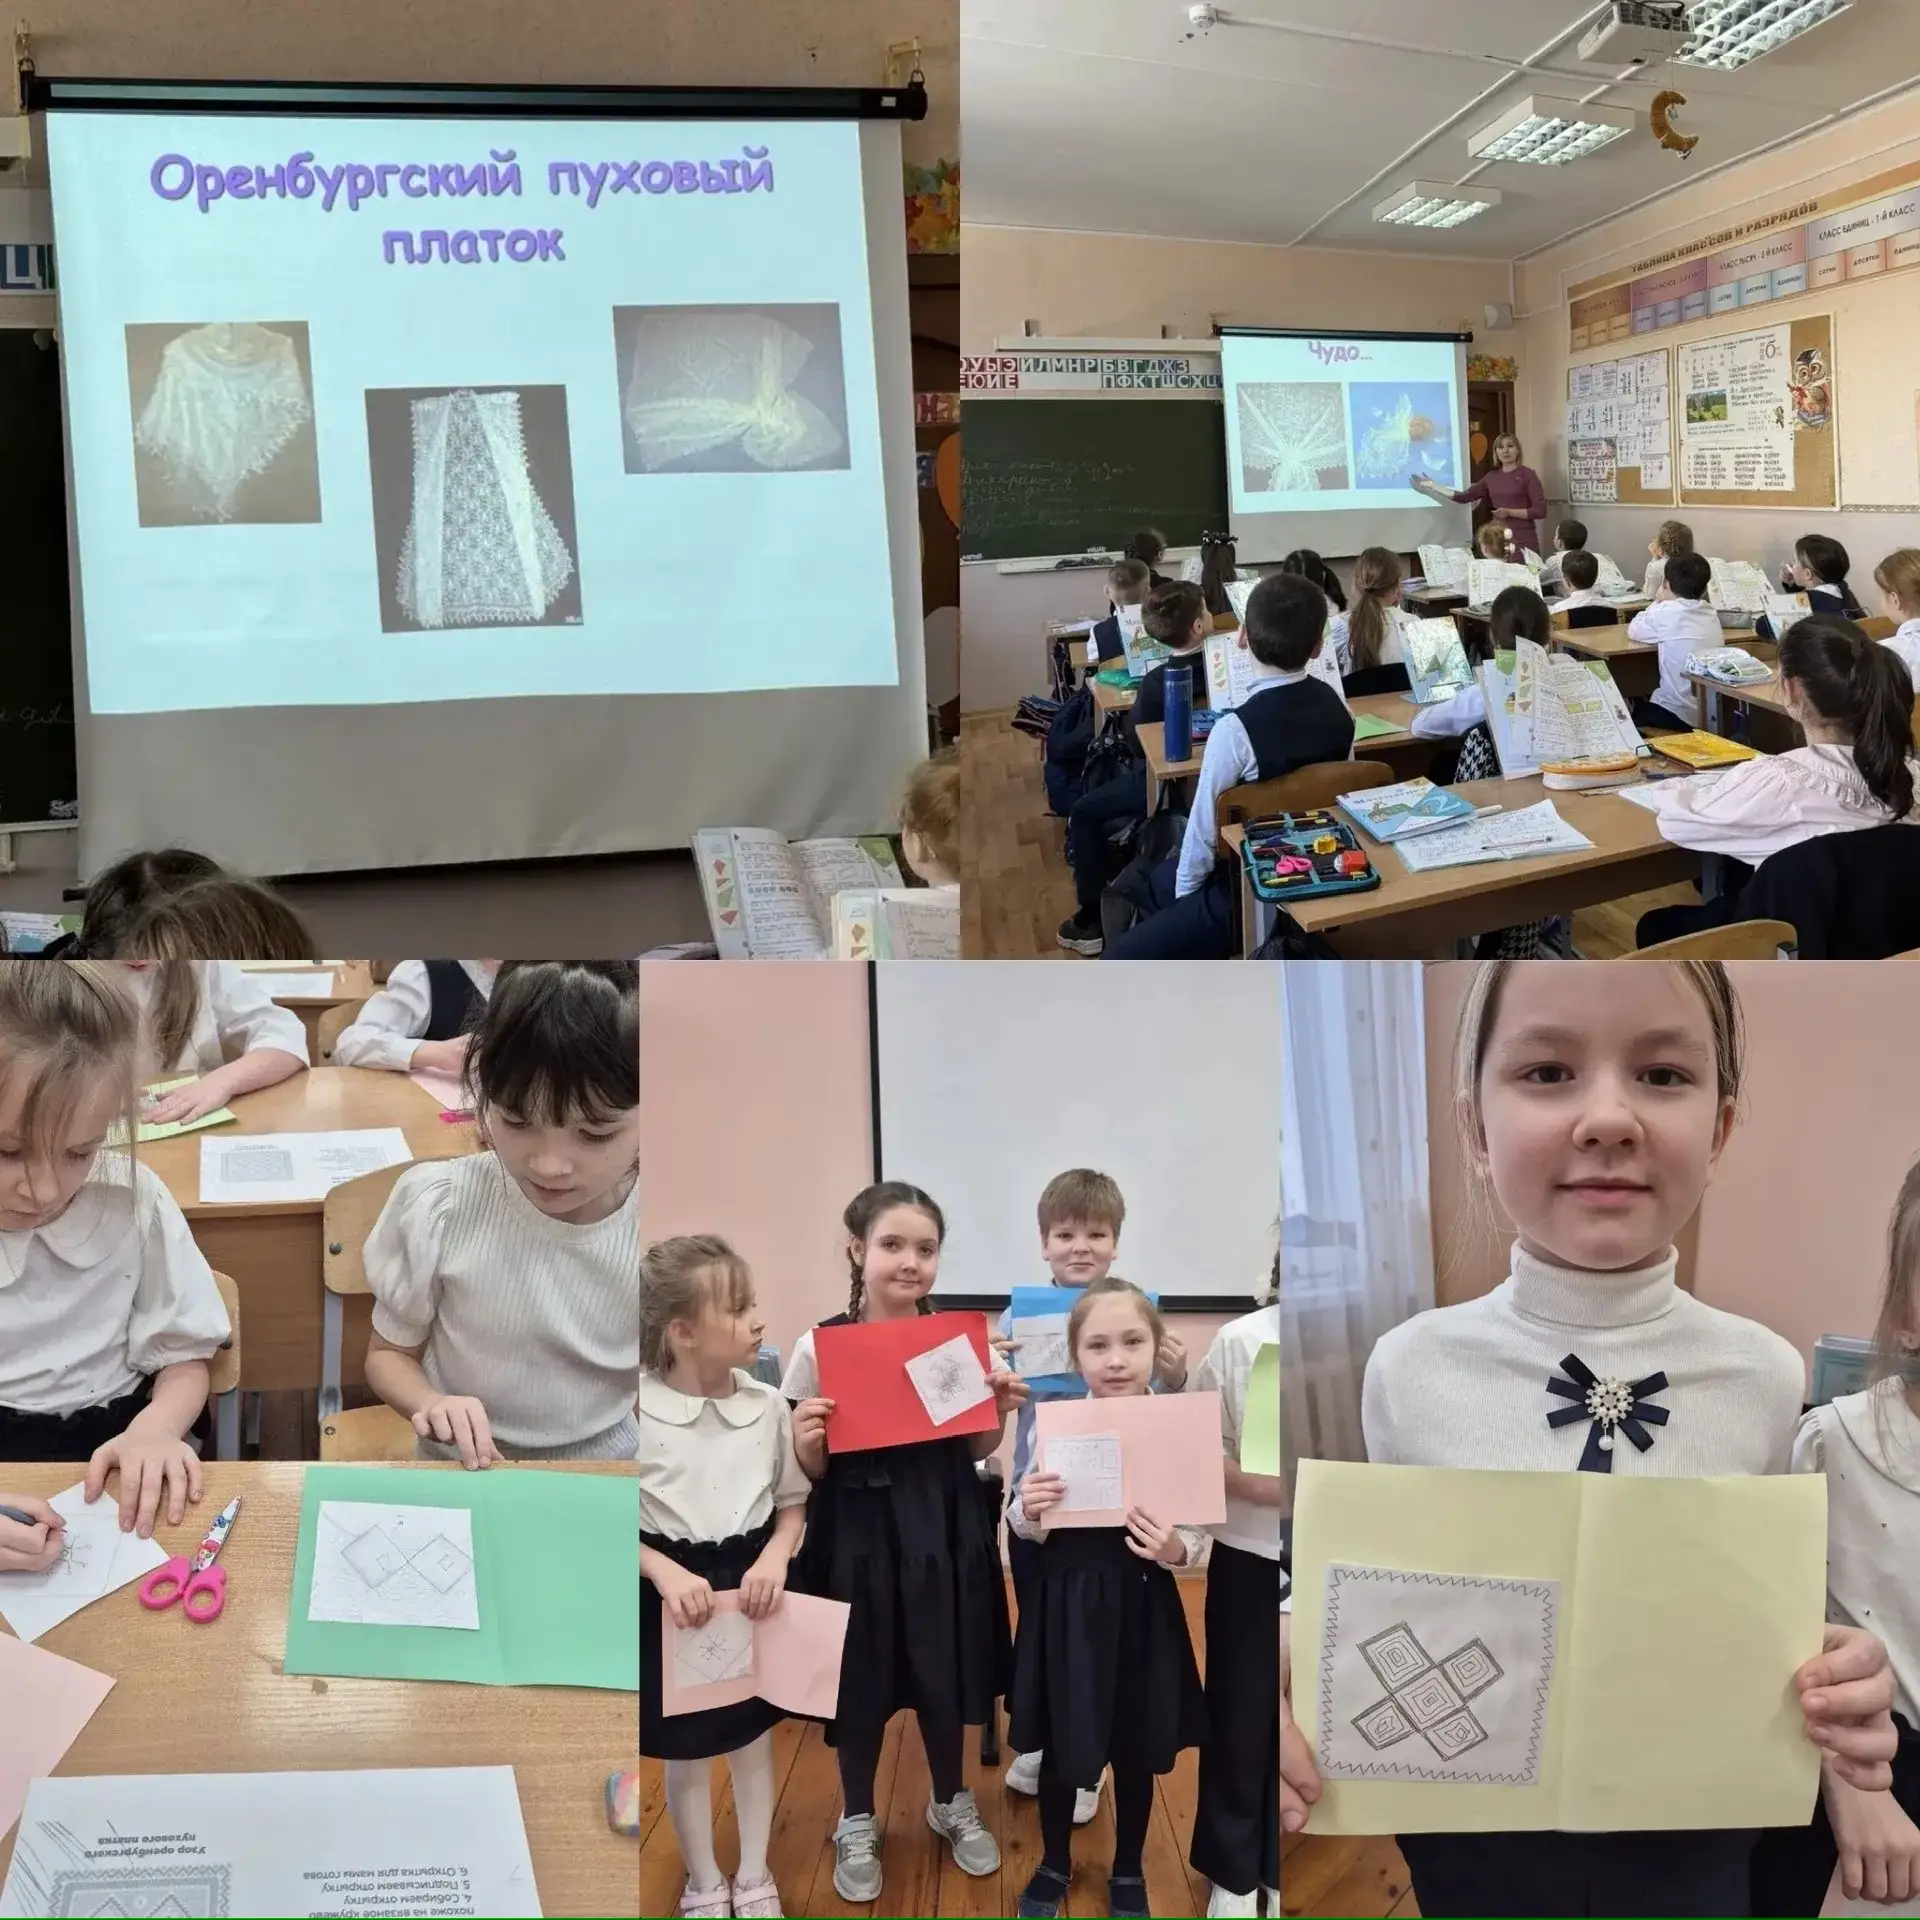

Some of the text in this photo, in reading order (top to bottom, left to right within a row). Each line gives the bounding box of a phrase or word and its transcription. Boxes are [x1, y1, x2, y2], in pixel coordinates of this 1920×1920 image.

[151, 145, 774, 213] Оренбургский пуховый
[1819, 227, 1841, 240] КЛАСС
[1842, 218, 1870, 233] ЕДИНИЦ
[1889, 203, 1915, 219] КЛАСС
[1629, 202, 1818, 273] ТАБЛИЦА КЛАССОВ И РАЗРЯДОВ
[382, 229, 566, 264] платок
[1308, 341, 1374, 366] Чудо...
[98, 1832, 196, 1845] пухового платка
[84, 1846, 206, 1858] Узор оренбургского
[303, 1867, 468, 1880] 6. Открытка для мамы готова
[321, 1880, 470, 1893] 5. Подписываем открытку
[344, 1894, 472, 1905] 4. Собираем открытку
[308, 1907, 475, 1919] похоже на вязаное кружево
